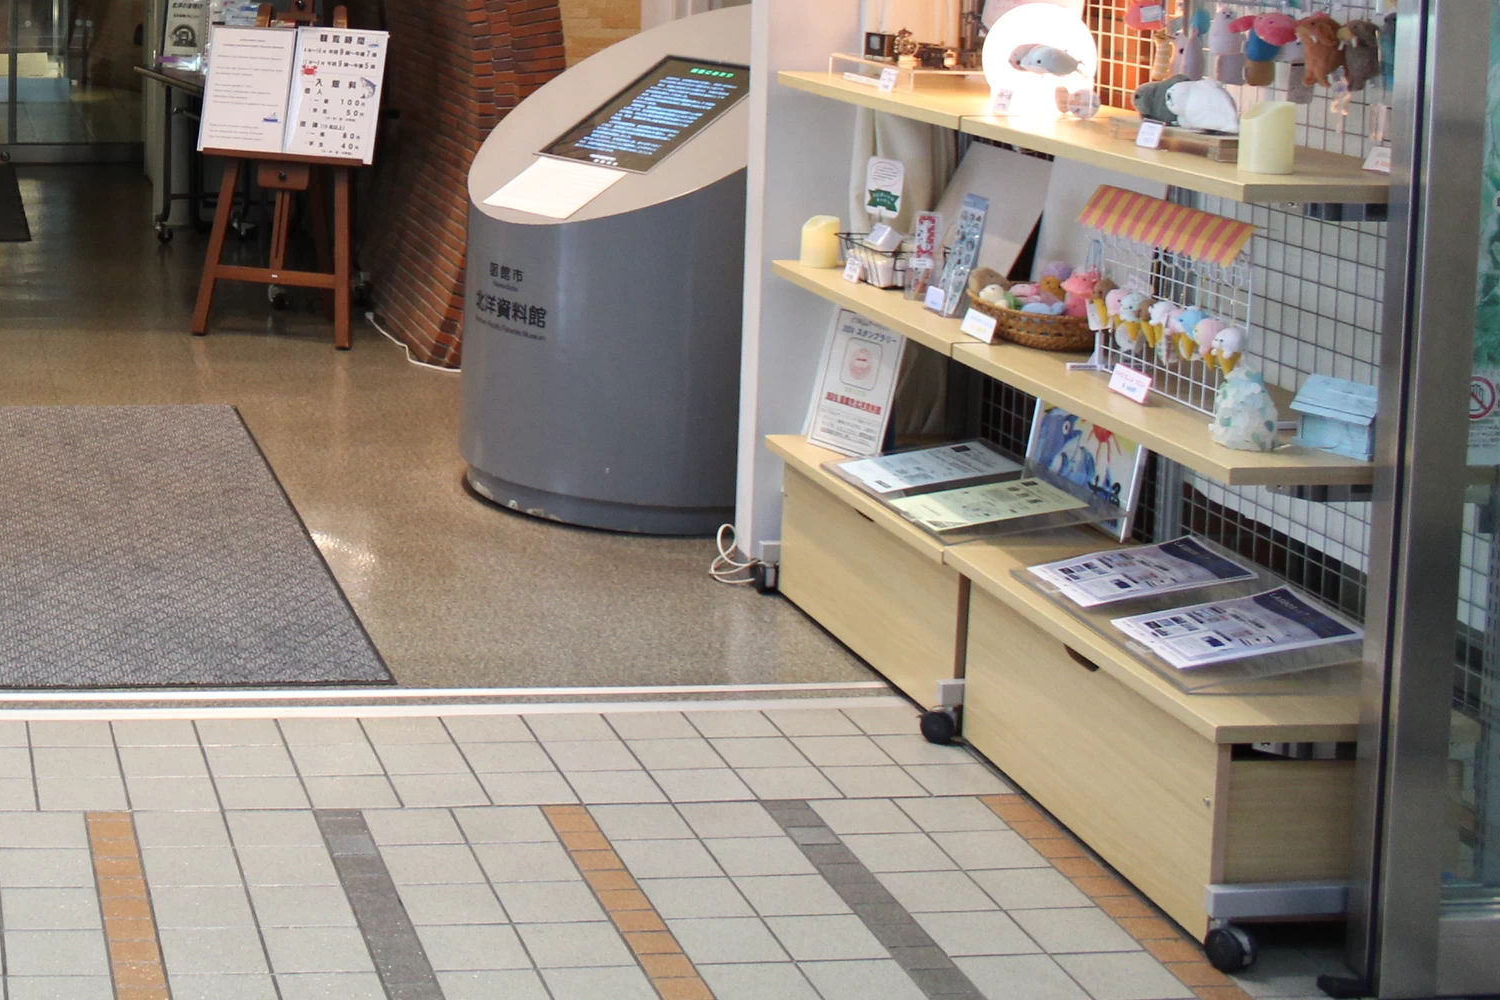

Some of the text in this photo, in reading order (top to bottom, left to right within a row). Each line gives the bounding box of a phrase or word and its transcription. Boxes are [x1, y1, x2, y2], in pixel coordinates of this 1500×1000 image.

[490, 262, 524, 282] 函館市
[476, 289, 546, 328] 北洋資料館
